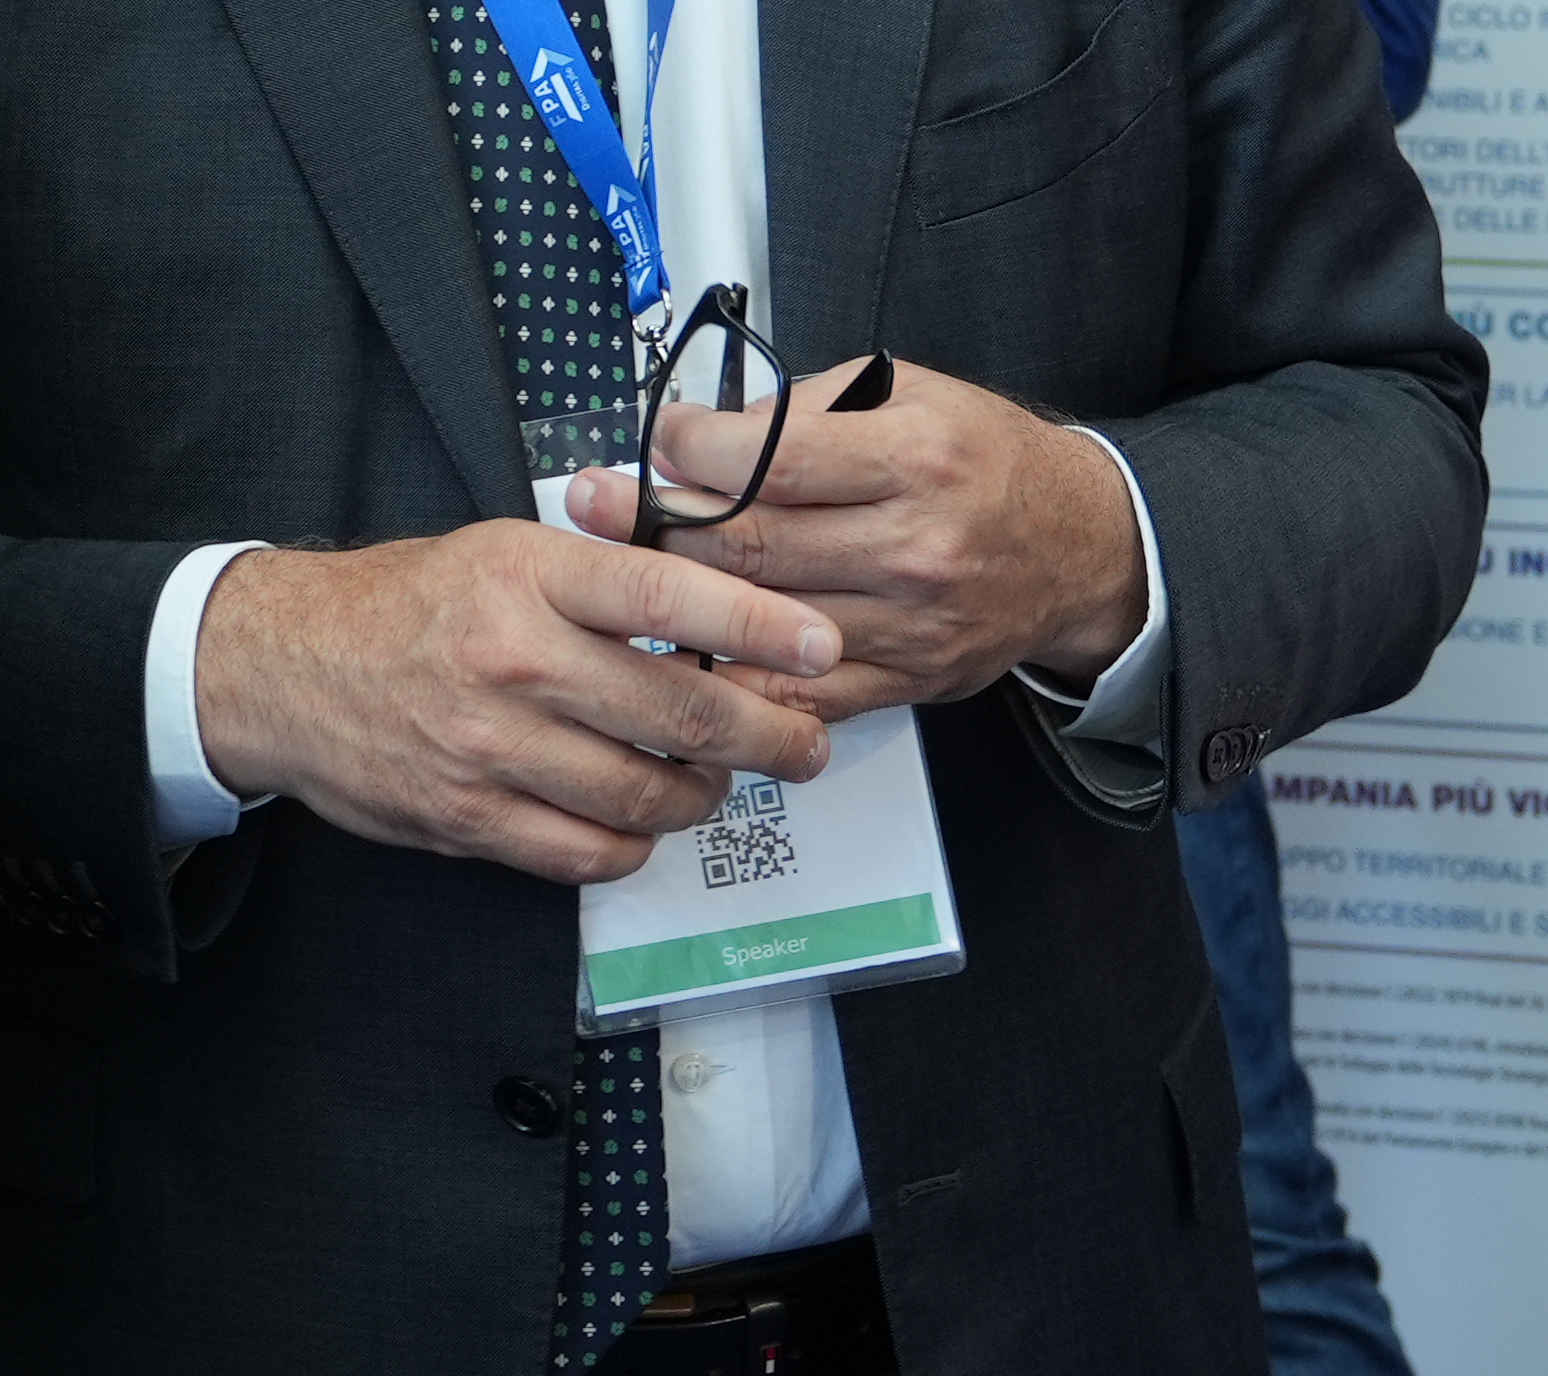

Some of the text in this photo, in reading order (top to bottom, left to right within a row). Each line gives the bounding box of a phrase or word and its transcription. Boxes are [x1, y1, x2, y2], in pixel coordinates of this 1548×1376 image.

[534, 79, 567, 128] FPA
[1509, 89, 1527, 116] E
[1420, 168, 1545, 201] RUTTURE
[1454, 204, 1540, 235] DELLE
[1532, 617, 1548, 644] E
[1430, 777, 1495, 816] PIÙ
[1355, 847, 1548, 887] TERRITORIALE
[1336, 898, 1503, 935] ACCESSIBILI
[1508, 906, 1526, 936] E
[721, 937, 809, 968] Speaker
